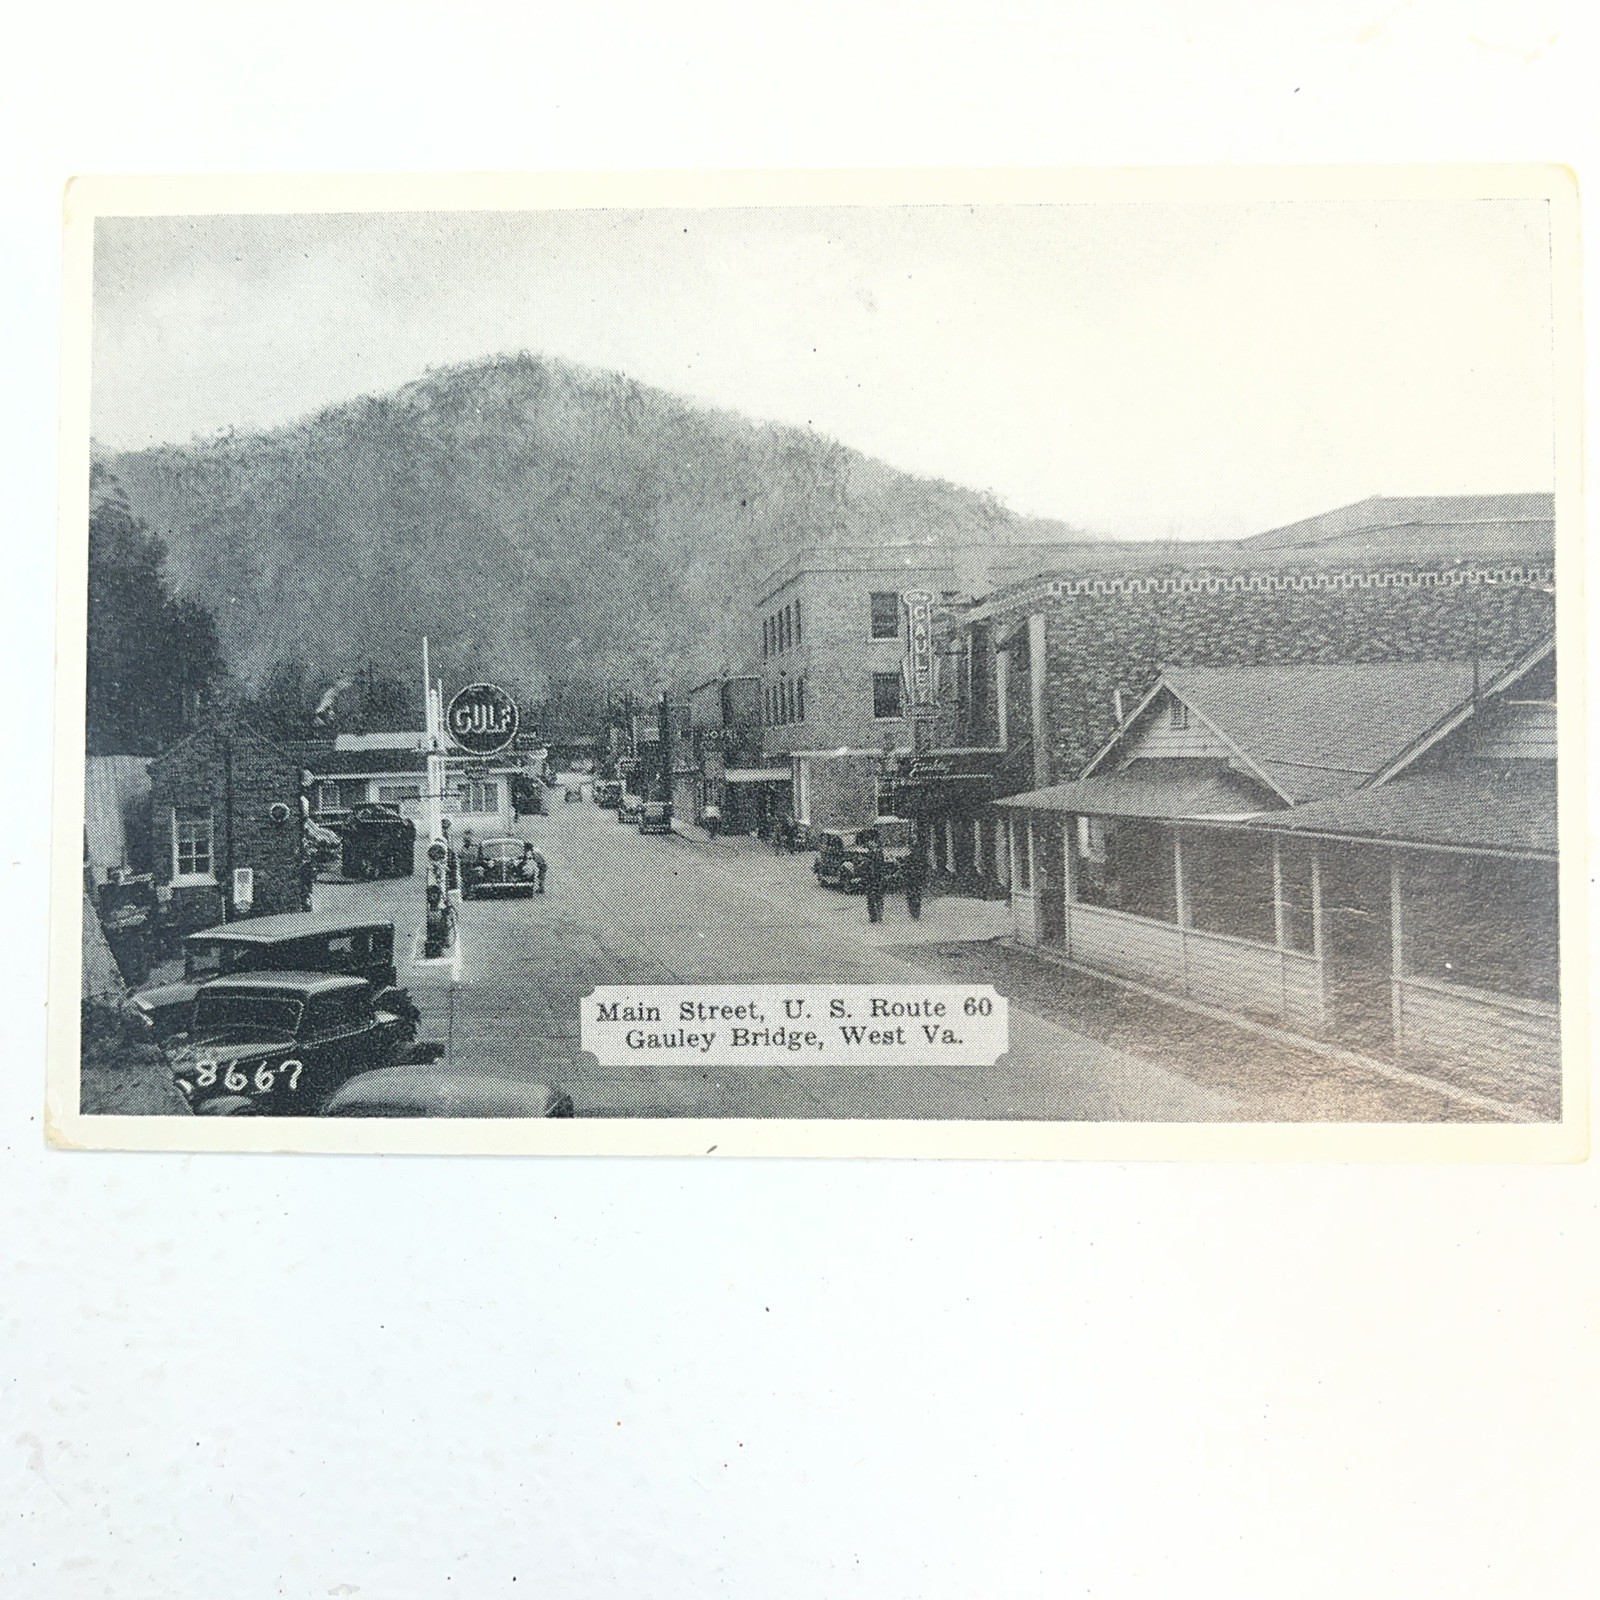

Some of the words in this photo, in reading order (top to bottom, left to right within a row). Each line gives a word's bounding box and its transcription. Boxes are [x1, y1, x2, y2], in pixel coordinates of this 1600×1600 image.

[456, 704, 512, 734] GULF
[596, 1001, 661, 1022] Main
[678, 999, 765, 1024] Street,
[783, 999, 812, 1018] U.
[829, 998, 853, 1018] S.
[870, 997, 947, 1018] Route
[963, 996, 993, 1017] 60
[626, 1028, 716, 1052] Gauley
[730, 1027, 824, 1051] Bridge,
[839, 1026, 907, 1046] West
[922, 1025, 964, 1045] Va.
[196, 1059, 303, 1091] 8667
